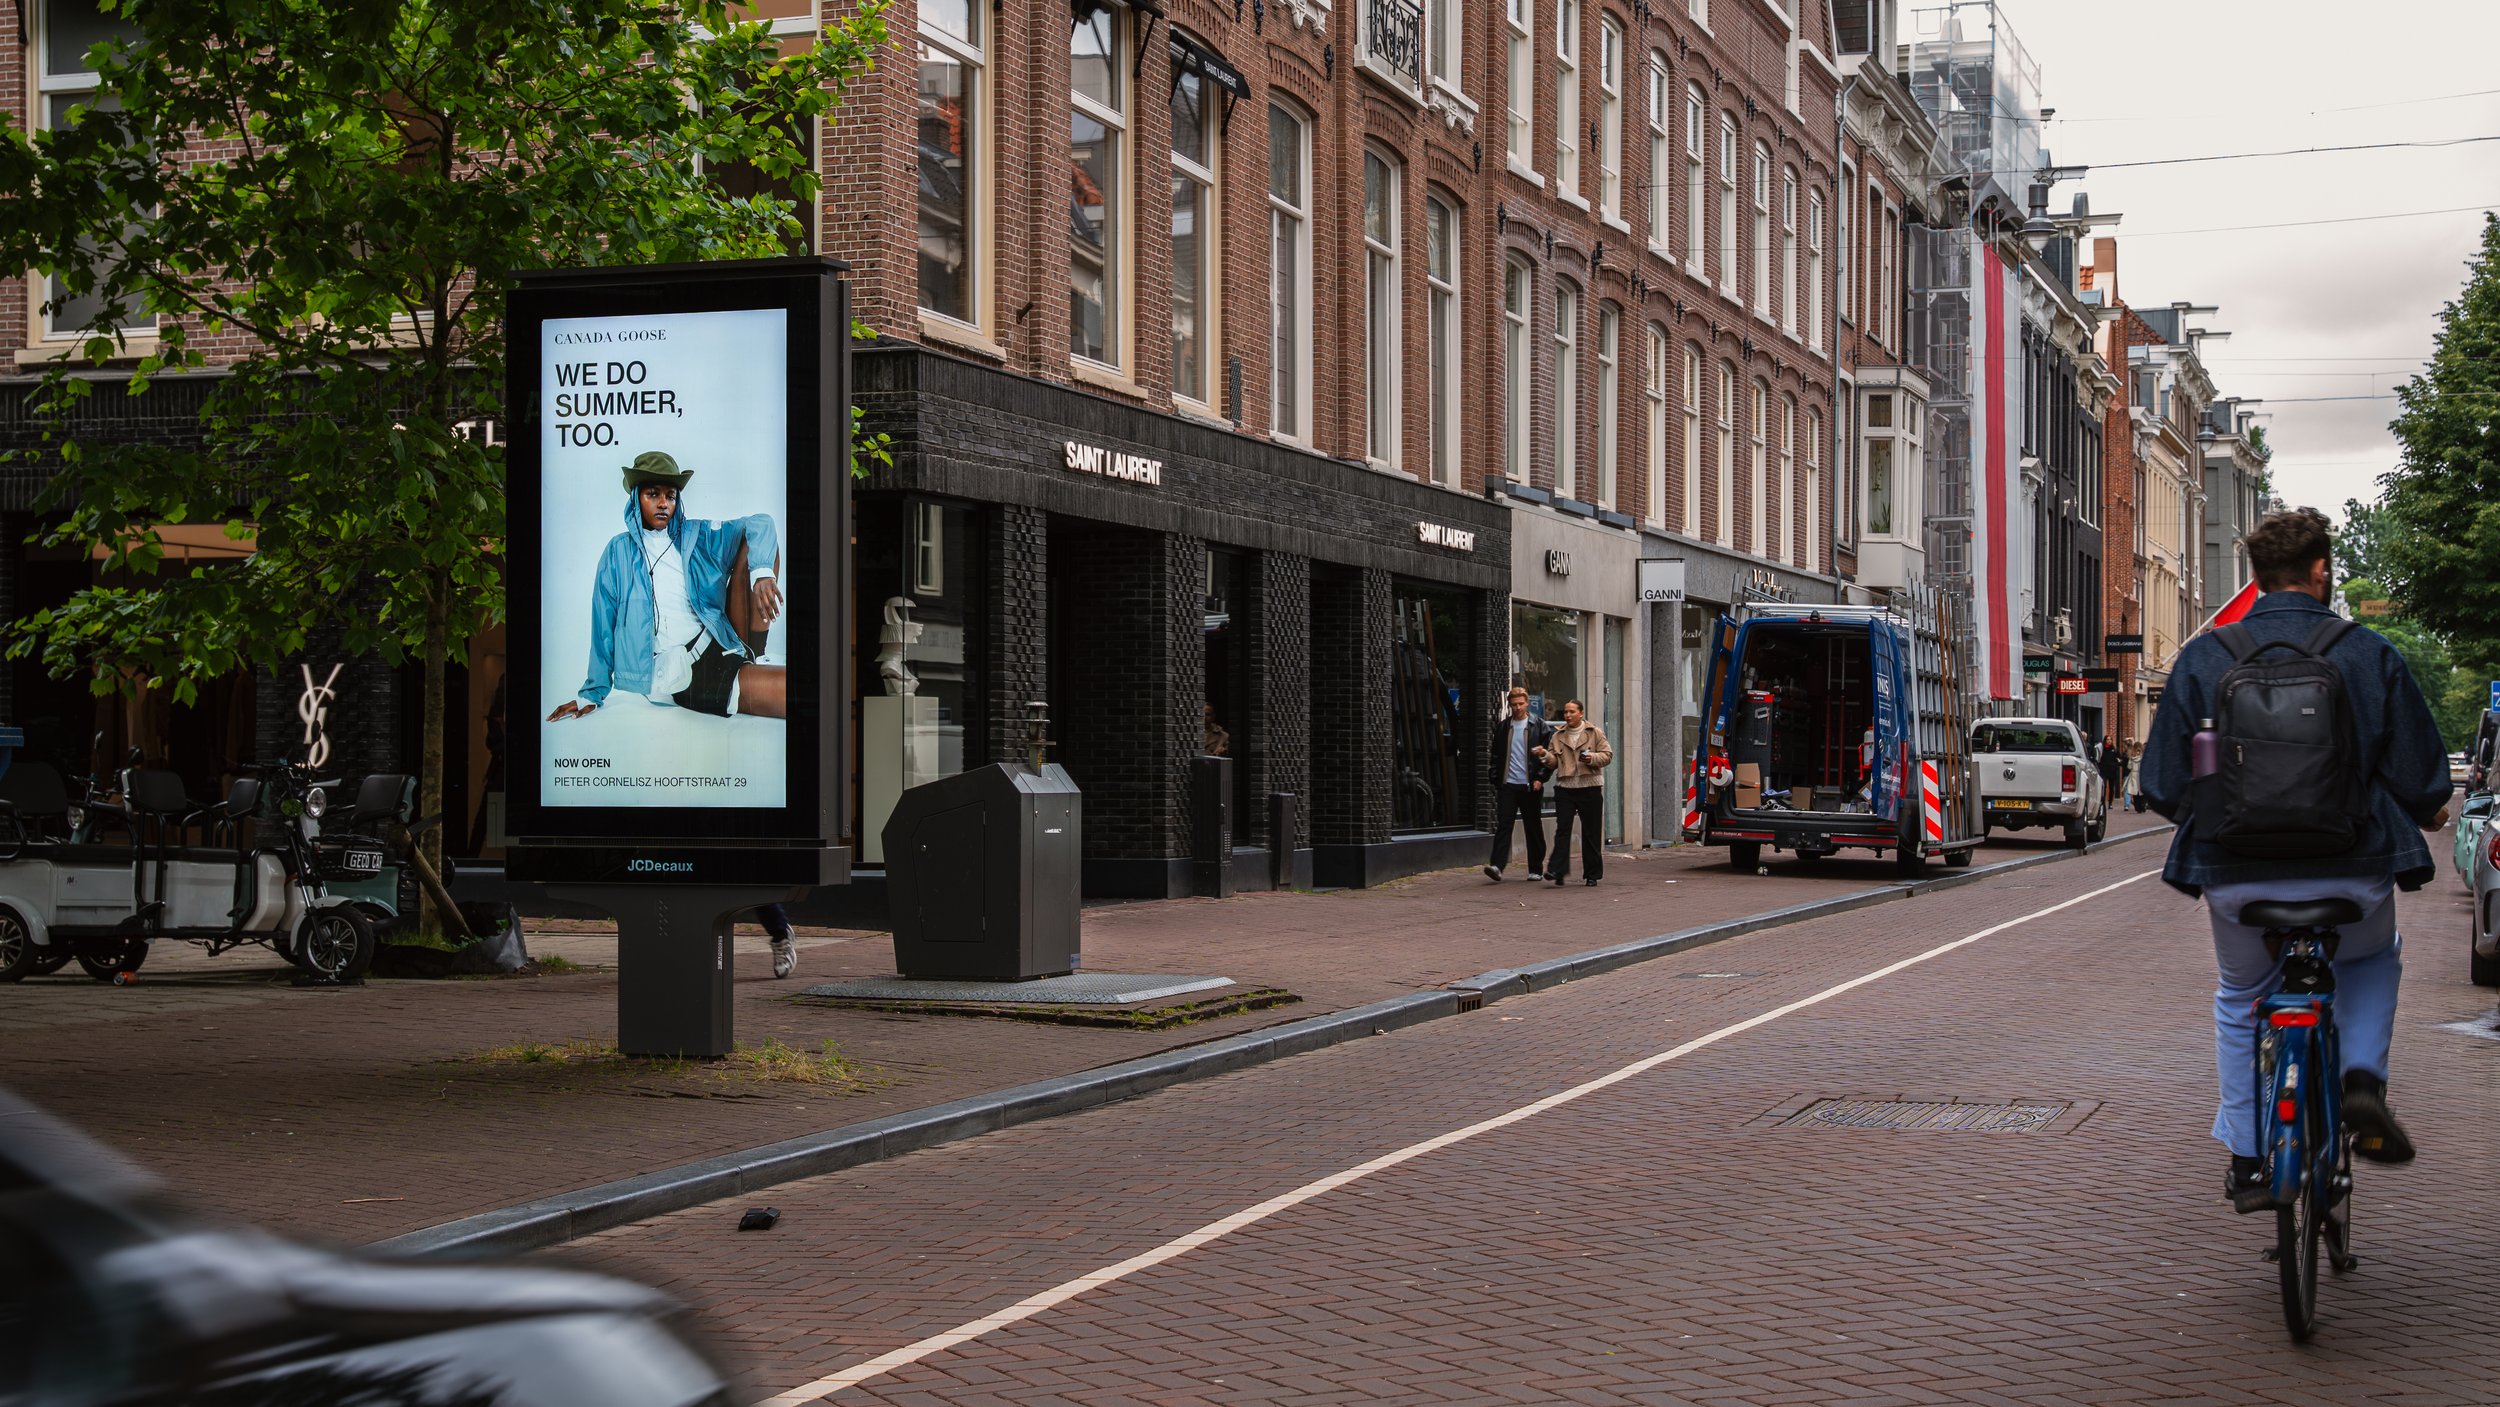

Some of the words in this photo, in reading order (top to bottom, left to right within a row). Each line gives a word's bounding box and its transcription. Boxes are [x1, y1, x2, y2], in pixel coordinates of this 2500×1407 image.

[554, 332, 613, 345] CANADA
[618, 329, 667, 342] GOOSE
[555, 362, 598, 387] WE
[606, 360, 647, 385] DO
[555, 390, 683, 418] SUMMER,
[555, 422, 619, 448] TOO.
[1065, 440, 1104, 474] SAINT
[1105, 450, 1162, 486] LAURENT
[1419, 520, 1441, 545] SAINT
[1441, 525, 1475, 552] LAURENT
[1644, 588, 1682, 600] GANNI
[2060, 680, 2086, 690] DIESEL
[554, 758, 579, 769] NOW
[581, 758, 611, 768] OPEN
[554, 777, 590, 787] PIETER
[592, 777, 652, 787] CORNELISZ
[654, 777, 731, 787] HOOFTSTRAAT
[734, 777, 747, 787] 29
[350, 854, 370, 868] GECO
[627, 859, 694, 872] JCDecaux
